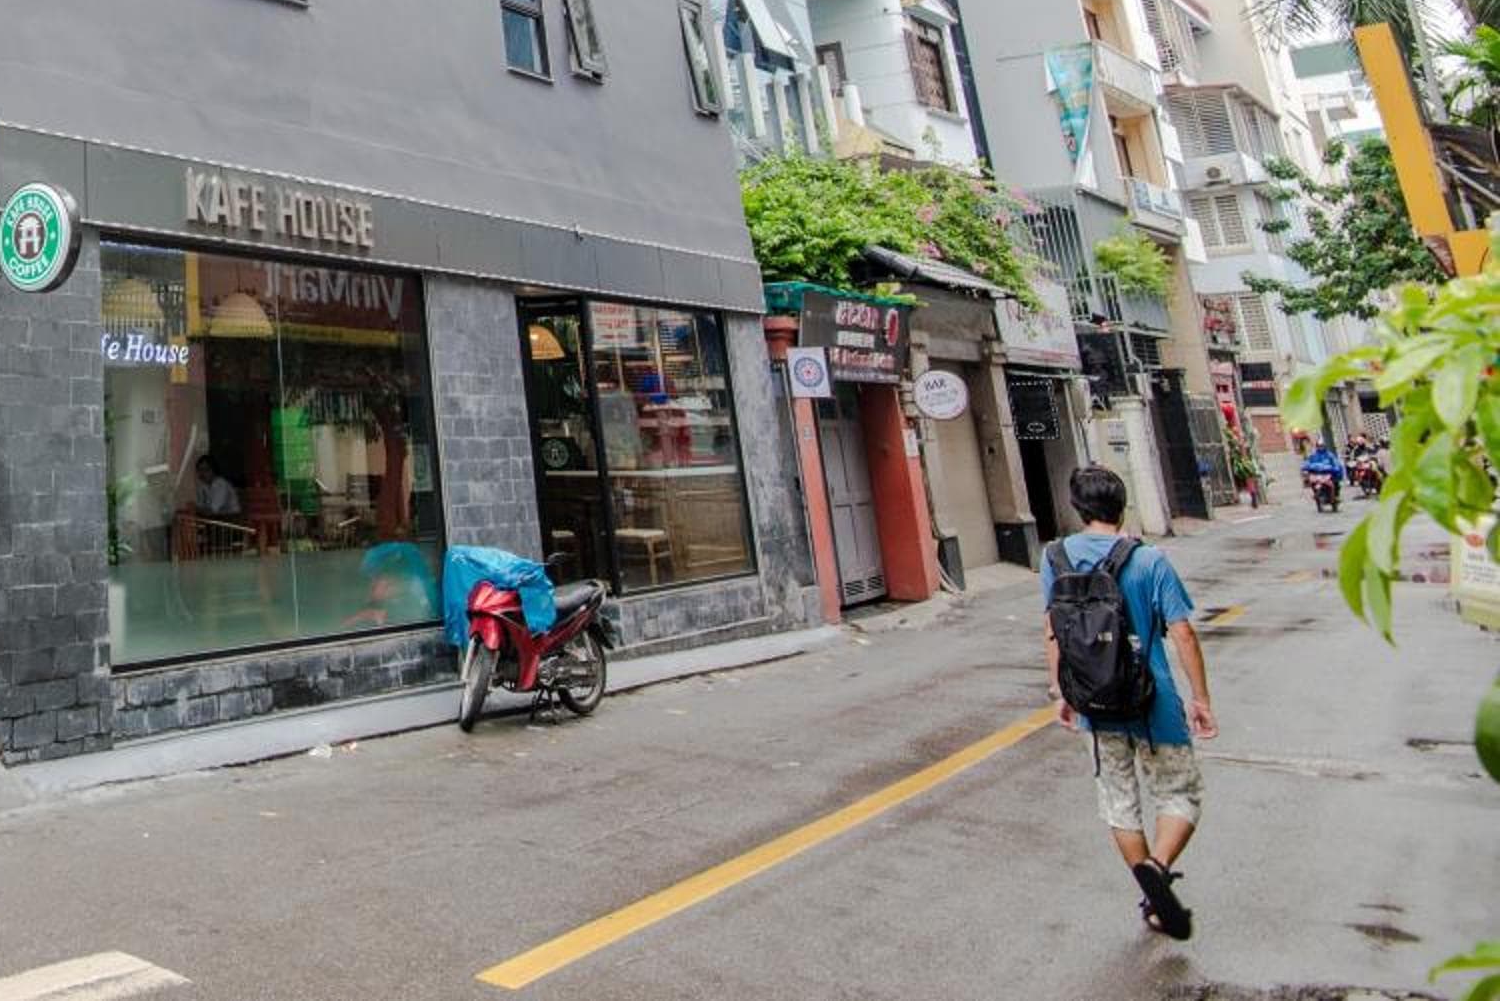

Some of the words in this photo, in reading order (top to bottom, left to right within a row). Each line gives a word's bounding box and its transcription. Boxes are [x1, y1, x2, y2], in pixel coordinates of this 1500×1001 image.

[185, 166, 267, 231] KAFE
[276, 183, 373, 249] HOUSE
[8, 254, 51, 278] COFFEE
[100, 332, 121, 360] fe
[123, 333, 190, 365] House
